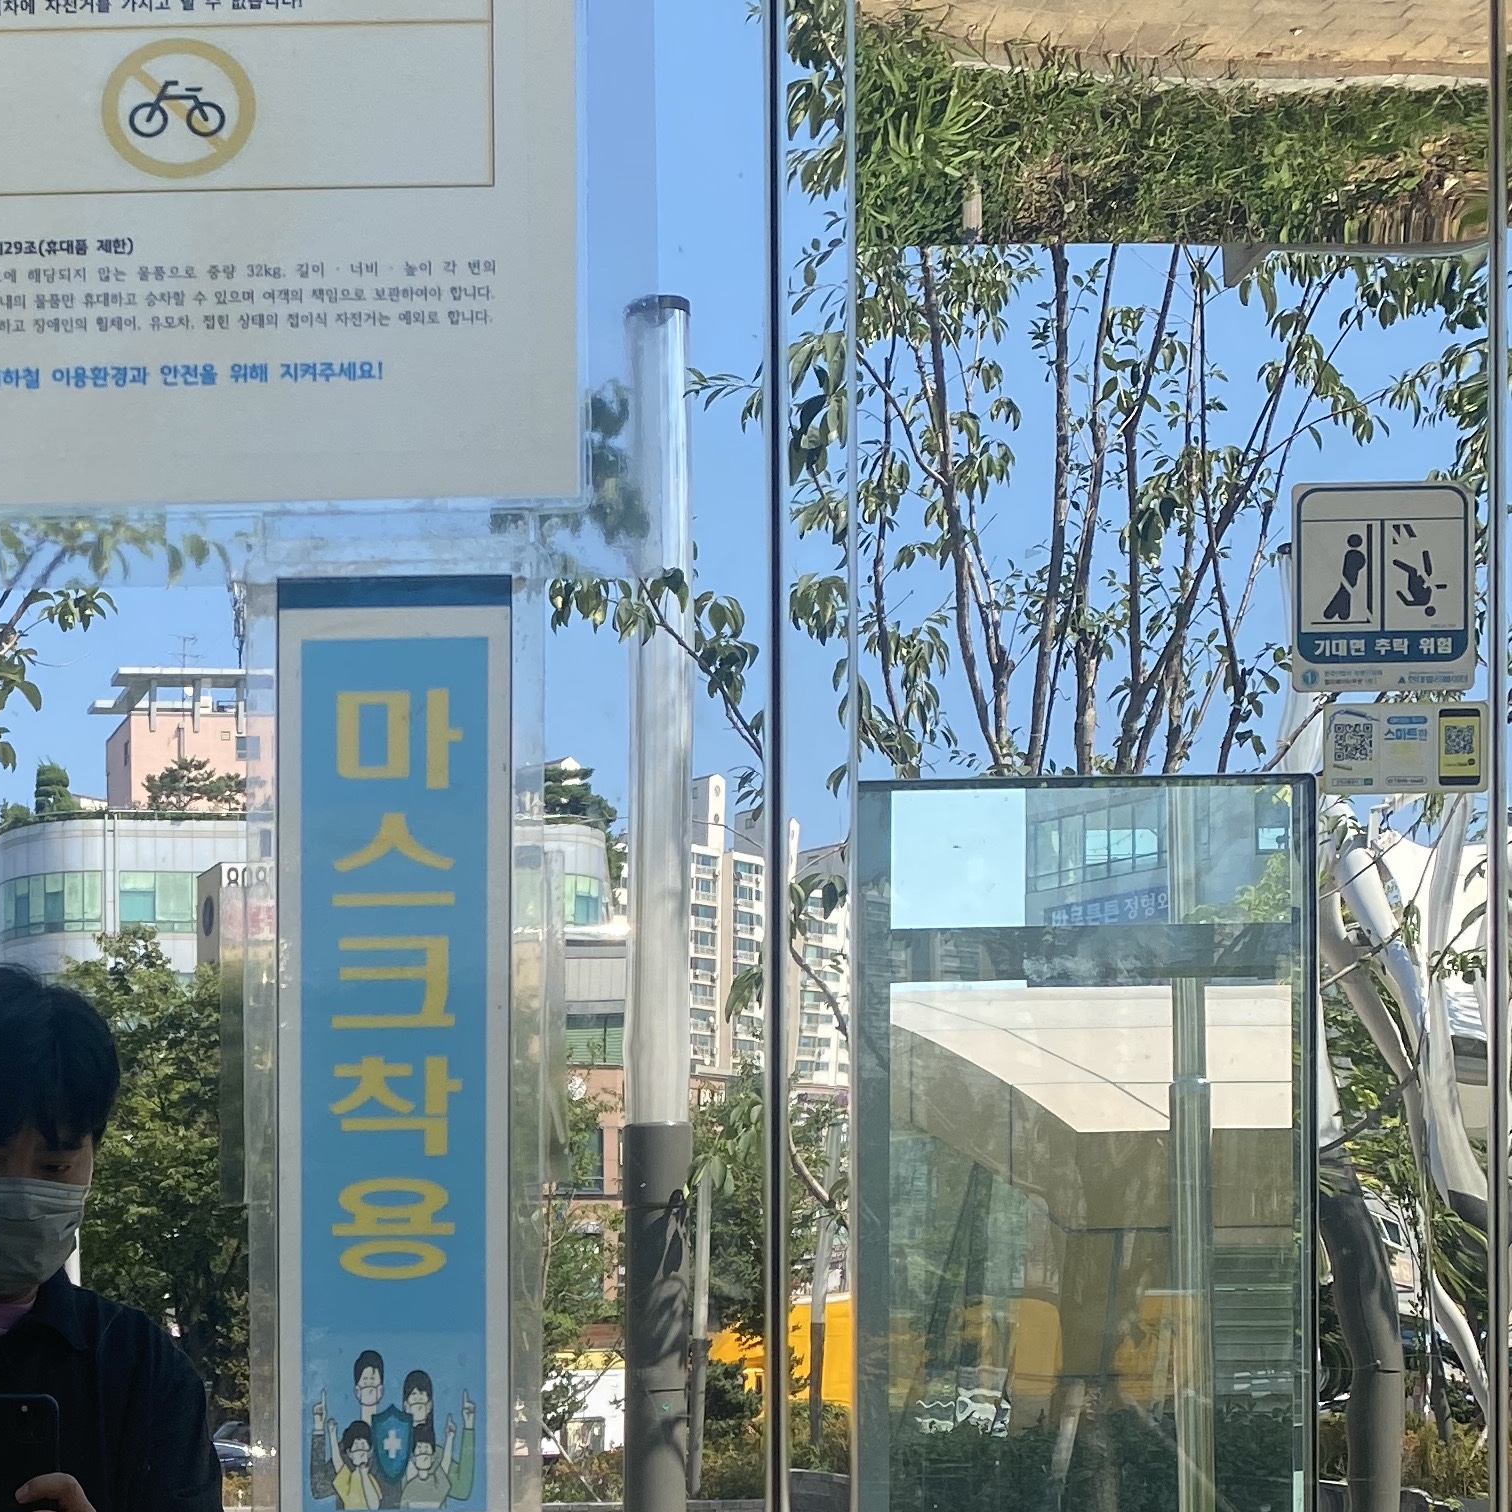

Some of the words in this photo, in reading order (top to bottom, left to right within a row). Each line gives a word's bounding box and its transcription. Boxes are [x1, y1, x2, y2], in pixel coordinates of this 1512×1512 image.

[96, 237, 133, 256] 제한)
[28, 267, 86, 284] 해당되지
[98, 266, 126, 282] 않는
[137, 266, 198, 281] 물품으로
[207, 264, 236, 280] 중량
[296, 262, 324, 278] 길이
[350, 261, 378, 277] 너비
[404, 260, 431, 277] 높이
[444, 260, 457, 275] 각
[468, 260, 495, 275] 변의
[34, 293, 75, 310] 물품만
[82, 292, 137, 308] 휴대하고
[192, 291, 207, 306] 수
[214, 289, 254, 305] 있으며
[263, 288, 302, 304] 여객의
[311, 288, 366, 303] 책임으로
[33, 317, 87, 334] 장애인의
[238, 312, 278, 329] 상태의
[335, 311, 390, 327] 자전거는
[52, 366, 150, 389] 이용환경과
[160, 363, 218, 386] 안전을
[230, 363, 268, 383] 위해
[280, 361, 383, 383] 지켜주세요!
[1314, 638, 1366, 657] 기대면
[1375, 637, 1409, 656] 추락
[1418, 636, 1453, 655] 위험
[329, 688, 464, 1281] 마스크착용
